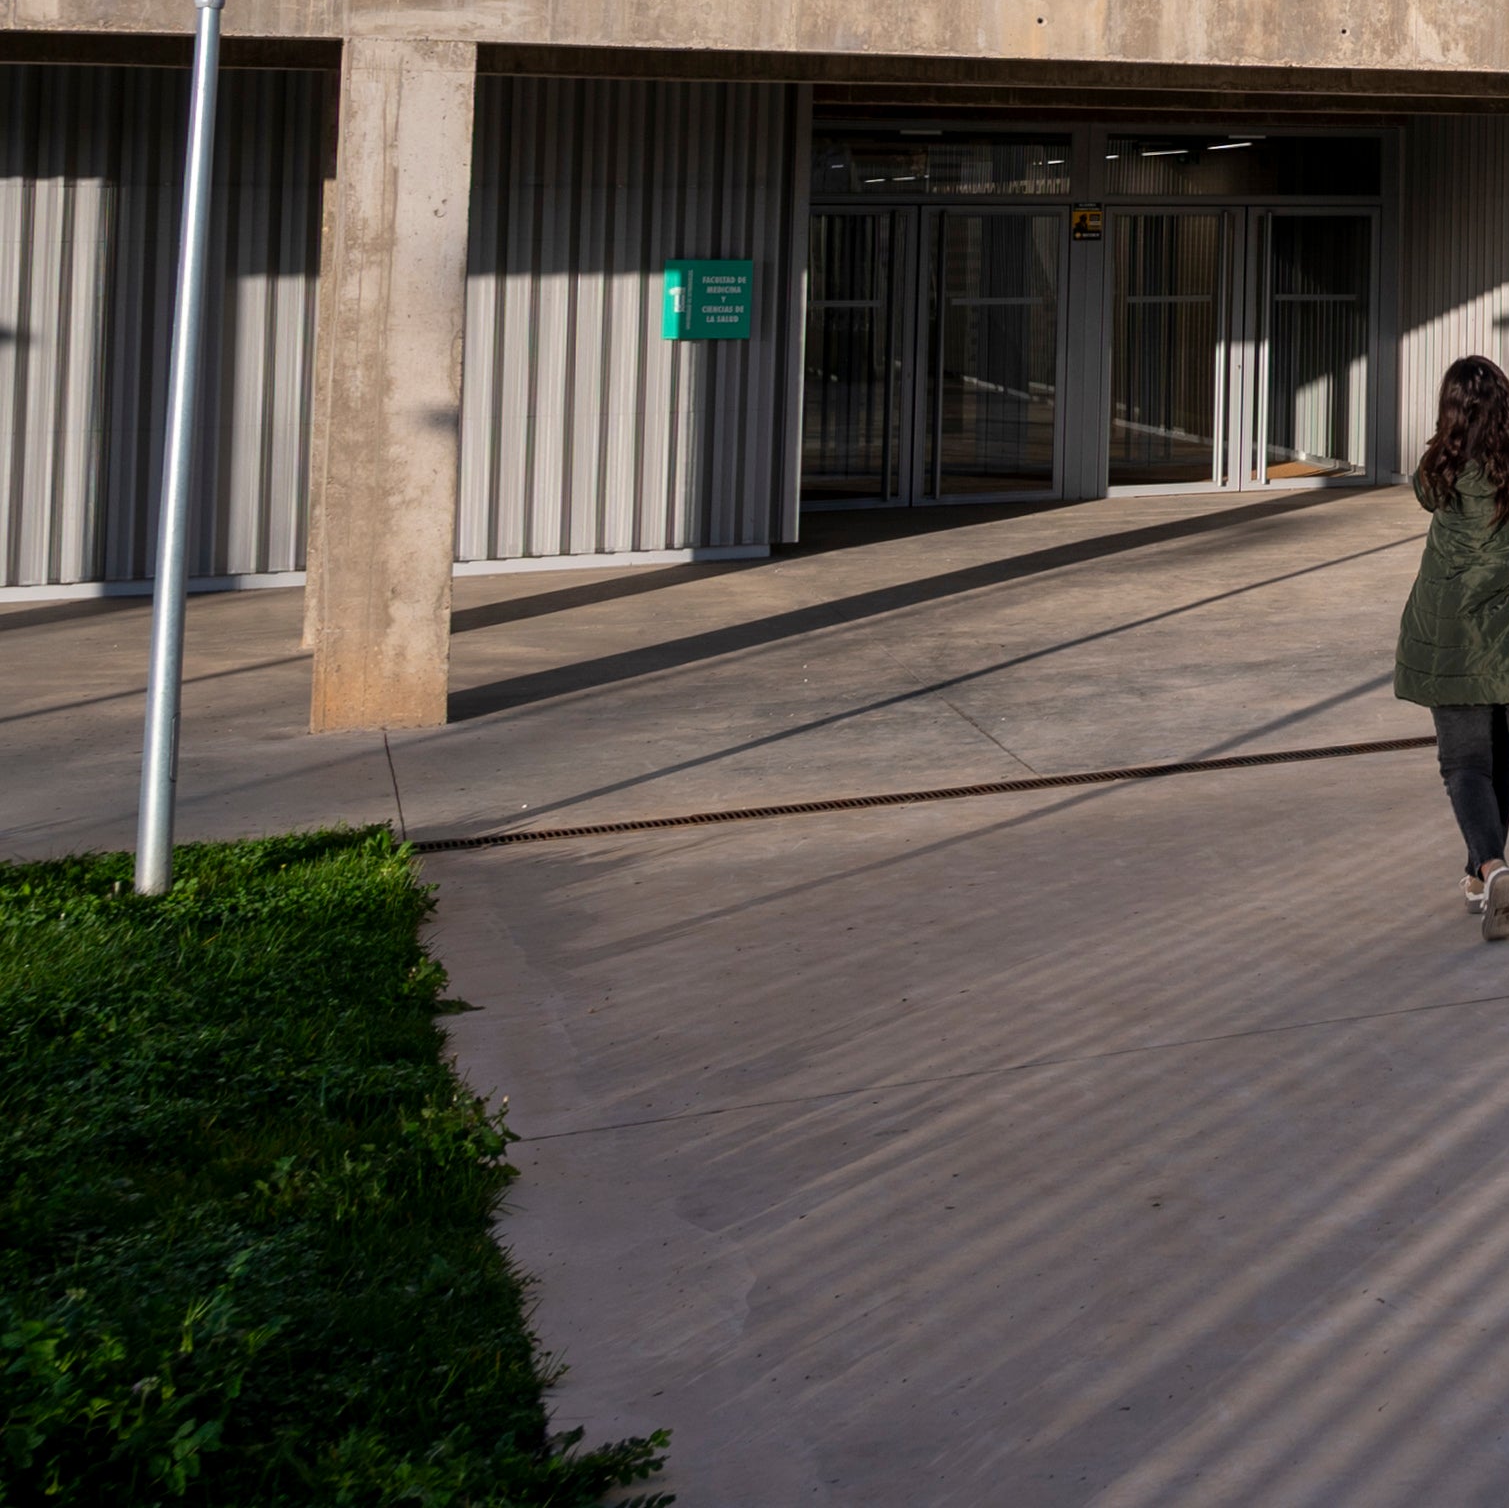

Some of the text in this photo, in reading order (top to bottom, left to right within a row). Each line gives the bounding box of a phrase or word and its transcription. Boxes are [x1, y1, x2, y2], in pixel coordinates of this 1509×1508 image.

[702, 276, 747, 284] FACULTAD DE
[706, 286, 742, 294] MEDICINA
[701, 305, 744, 313] CIENCIAS DE
[706, 315, 739, 323] LA SALUD
